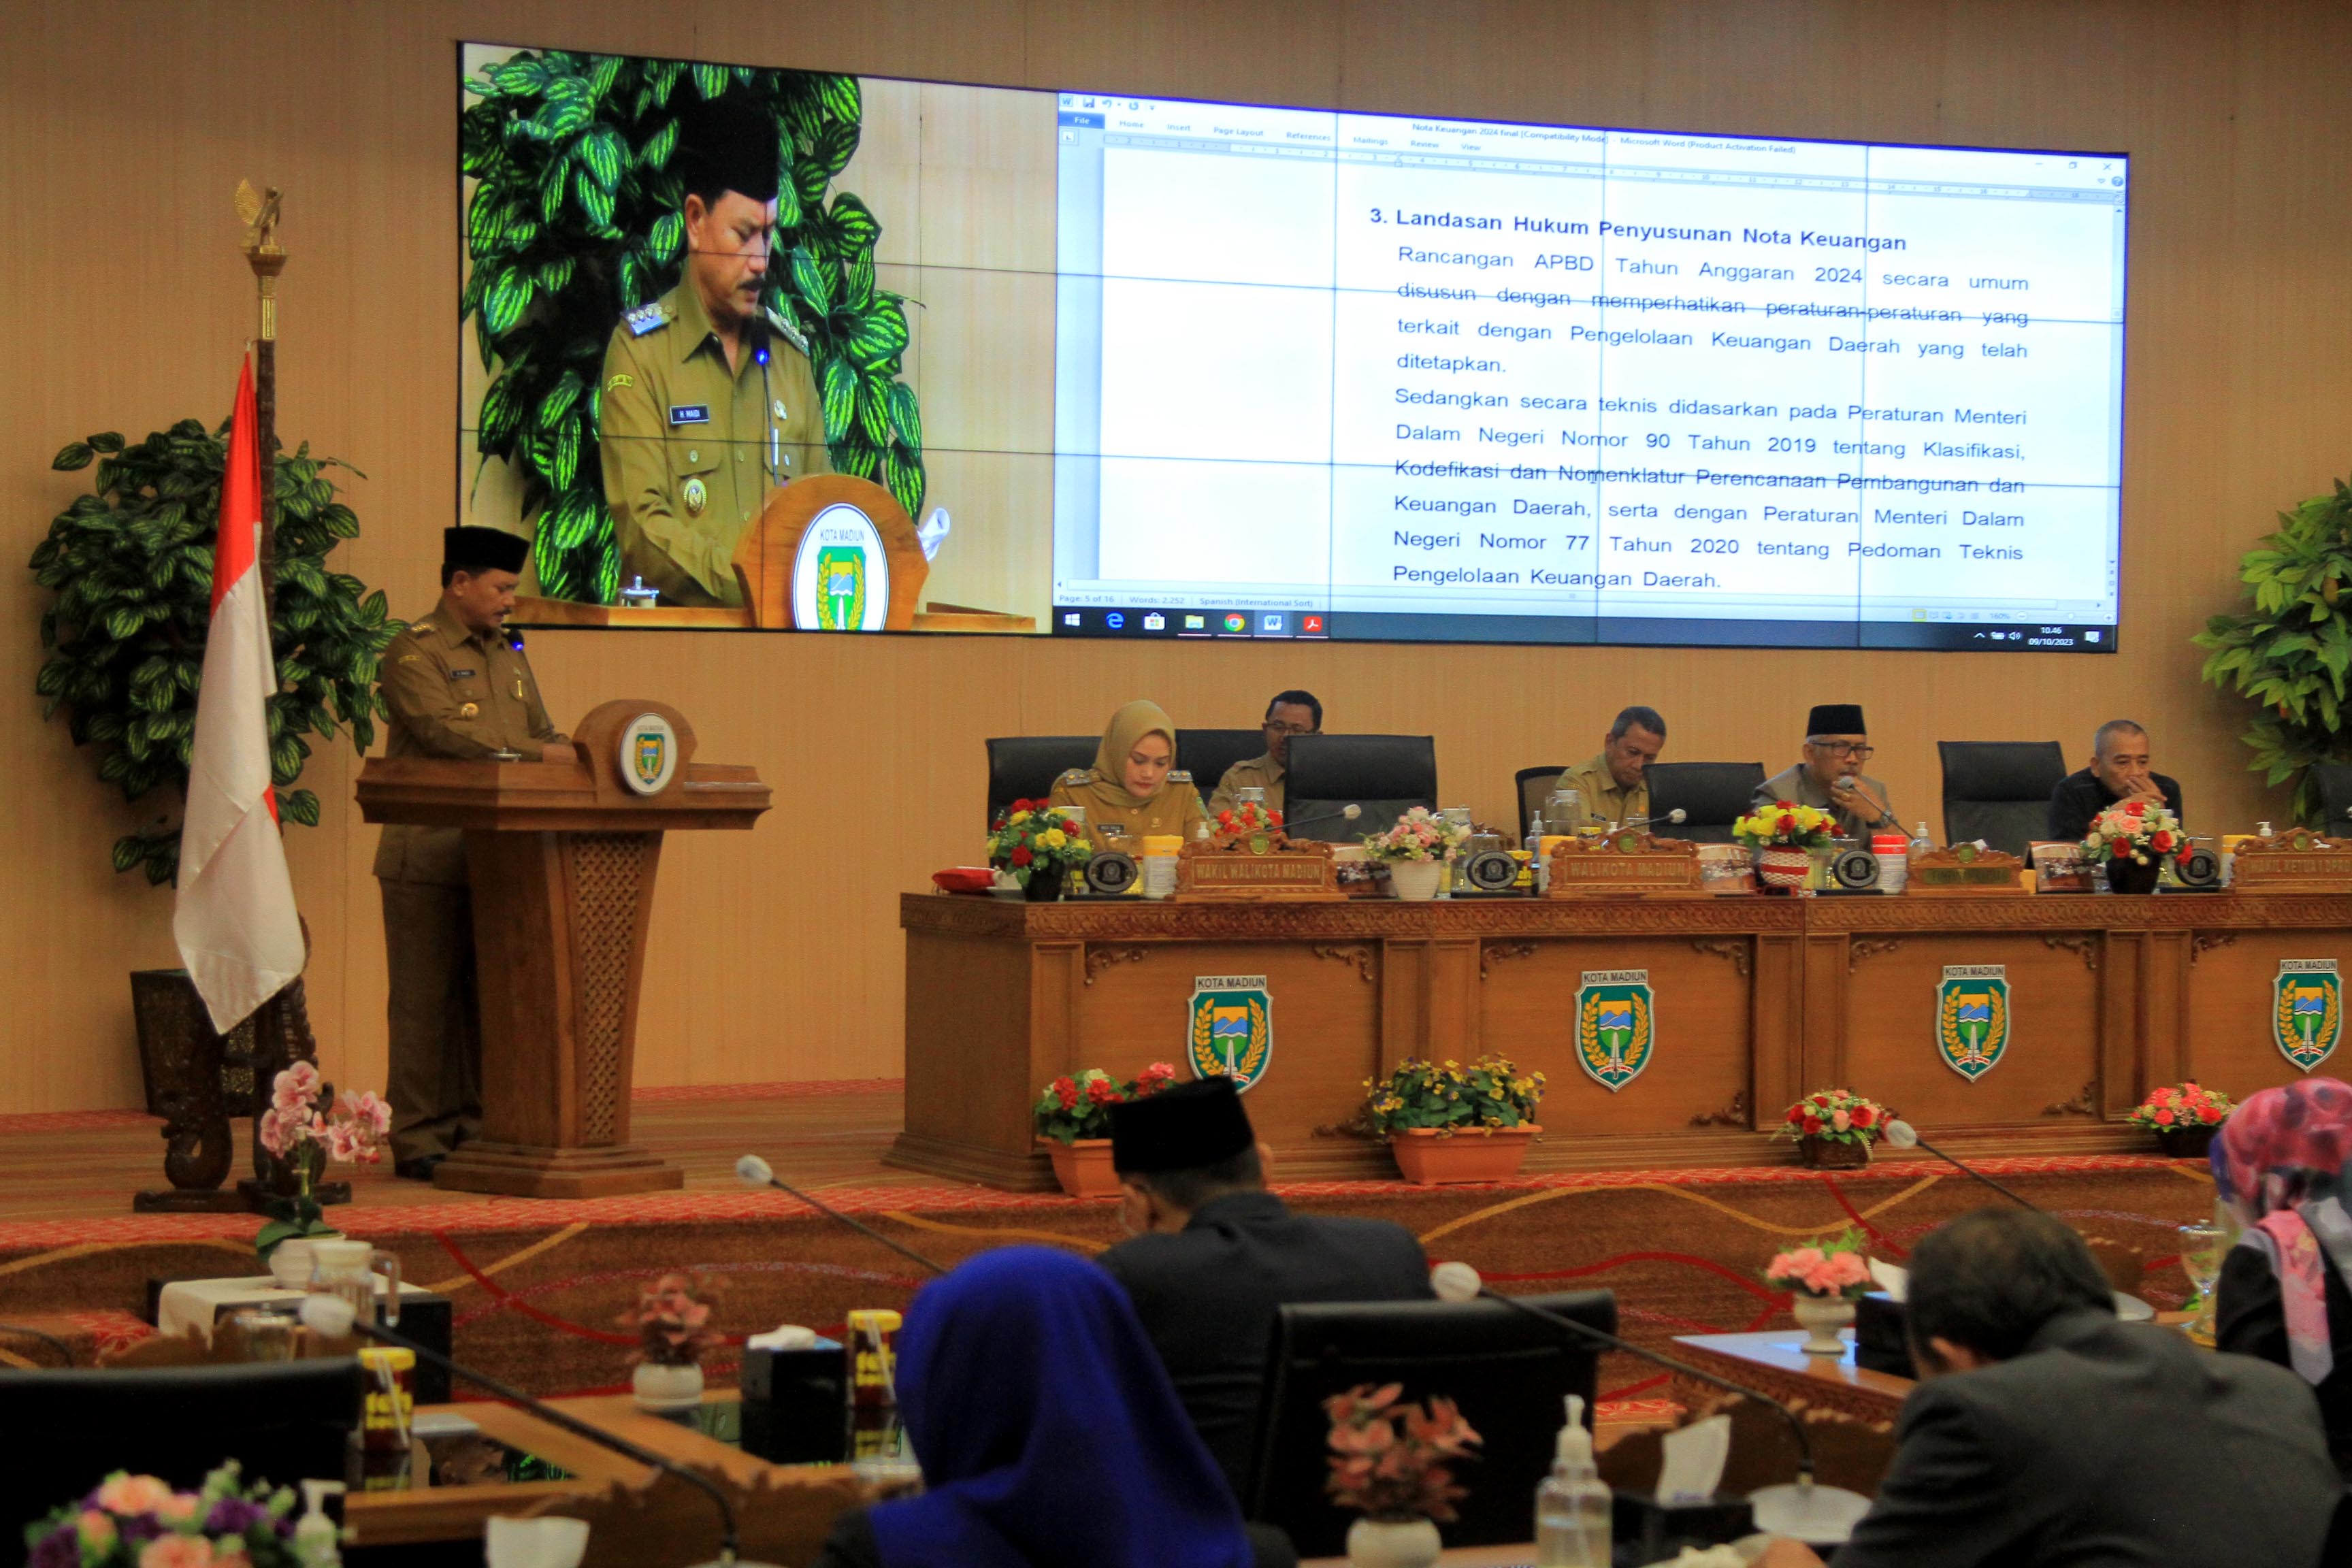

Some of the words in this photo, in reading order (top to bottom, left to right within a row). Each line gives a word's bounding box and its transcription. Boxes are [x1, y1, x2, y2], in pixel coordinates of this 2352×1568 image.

[1075, 116, 1090, 125] File
[1120, 120, 1145, 129] Home
[1168, 123, 1191, 131] Insert
[1214, 126, 1234, 137] Page
[1237, 129, 1264, 138] Layout
[1286, 131, 1331, 141] References
[1354, 136, 1388, 147] Mailings
[1411, 140, 1439, 148] Review
[1462, 143, 1481, 151] View
[1413, 122, 1433, 132] Nota
[1435, 125, 1477, 137] Keuangan
[1480, 127, 1499, 135] 2024
[1501, 129, 1518, 137] final
[1521, 130, 1580, 143] [Compatibility
[1620, 137, 1660, 146] Microsoft
[1663, 140, 1686, 148] Word
[1688, 140, 1723, 150] (Product
[1725, 142, 1767, 152] Activation
[1769, 144, 1796, 154] Failed)
[1371, 208, 1387, 223] 3.
[1397, 210, 1501, 229] Landasan
[1515, 216, 1588, 234] Hukum
[1599, 221, 1731, 242] Penyusunan
[1744, 229, 1791, 244] Nota
[1801, 231, 1906, 252] Keuangan
[1399, 246, 1513, 269] Rancangan
[1535, 255, 1593, 271] APBD
[1616, 259, 1677, 274] Tahun
[1699, 263, 1793, 282] Anggaran
[1816, 267, 1862, 282] 2024
[1884, 274, 1948, 287] secara
[1970, 278, 2028, 290] umum
[1398, 283, 1475, 300] disusun
[1498, 288, 1570, 308] dengan
[1592, 295, 1745, 312] memperhatikan
[1766, 303, 1961, 322] peraturan-peraturan
[1982, 312, 2028, 327] yang
[1399, 319, 1458, 335] terkait
[1478, 323, 1551, 342] dengan
[1571, 326, 1692, 346] Pengelolaan
[1712, 332, 1810, 353] Keuangan
[1829, 337, 1899, 353] Daerah
[1918, 344, 1963, 359] yang
[1982, 343, 2027, 357] telah
[1397, 354, 1506, 374] ditetapkan.
[1396, 389, 1507, 409] Sedangkan
[1521, 397, 1586, 410] secara
[1599, 397, 1656, 412] teknis
[1669, 399, 1777, 416] didasarkan
[1790, 405, 1836, 421] pada
[1849, 406, 1943, 421] Peraturan
[1955, 409, 2025, 424] Menteri
[1397, 425, 1460, 440] Dalam
[1480, 427, 1543, 446] Negeri
[1563, 431, 1628, 446] Nomor
[1646, 434, 1669, 448] 90
[1688, 435, 1750, 451] Tahun
[1768, 438, 1816, 453] 2019
[1833, 440, 1905, 459] tentang
[1925, 442, 2024, 461] Klasifikasi,
[1395, 460, 1499, 478] Kodefikasi
[1510, 464, 1546, 479] dan
[1558, 466, 1686, 483] Nomenklatur
[1697, 470, 1826, 488] Perencanaan
[1838, 474, 1979, 494] Pembangunan
[1989, 478, 2025, 493] dan
[1395, 495, 1496, 516] Keuangan
[1514, 500, 1590, 519] Daerah,
[1609, 504, 1657, 517] serta
[1675, 504, 1746, 523] dengan
[1765, 506, 1858, 523] Peraturan
[1875, 509, 1946, 524] Menteri
[1963, 511, 2023, 526] Dalam
[820, 529, 838, 541] KOTA
[839, 529, 864, 541] MADIUN
[1394, 531, 1459, 550] Negeri
[1481, 534, 1546, 549] Nomor
[1567, 536, 1589, 550] 77
[1610, 536, 1671, 551] Tahun
[1691, 539, 1739, 553] 2020
[1758, 542, 1829, 559] tentang
[1849, 543, 1940, 558] Pedoman
[1959, 544, 2023, 559] Teknis
[1394, 566, 1519, 585] Pengelolaan
[1531, 570, 1631, 590] Keuangan
[1644, 572, 1720, 587] Daerah.
[1060, 594, 1083, 604] Page:
[1200, 598, 1233, 607] Spanish
[1235, 598, 1292, 607] (International
[1294, 600, 1313, 608] Sort)
[2028, 638, 2074, 646] 09/10/2023
[1196, 864, 1228, 879] WAKIL
[1230, 864, 1279, 879] WALIKOTA
[1282, 863, 1320, 879] MADIUN
[1570, 862, 1634, 877] WALIKOTA
[1637, 862, 1686, 877] MADIUN
[1584, 973, 1609, 983] KOTA
[1611, 972, 1647, 981] MADIUN
[1945, 967, 1969, 976] KOTA
[1970, 967, 2004, 976] MADIUN
[2281, 961, 2303, 970] KOTA
[2305, 961, 2336, 969] MADIUN
[1198, 978, 1224, 987] KOTA
[1227, 977, 1265, 987] MADIUN
